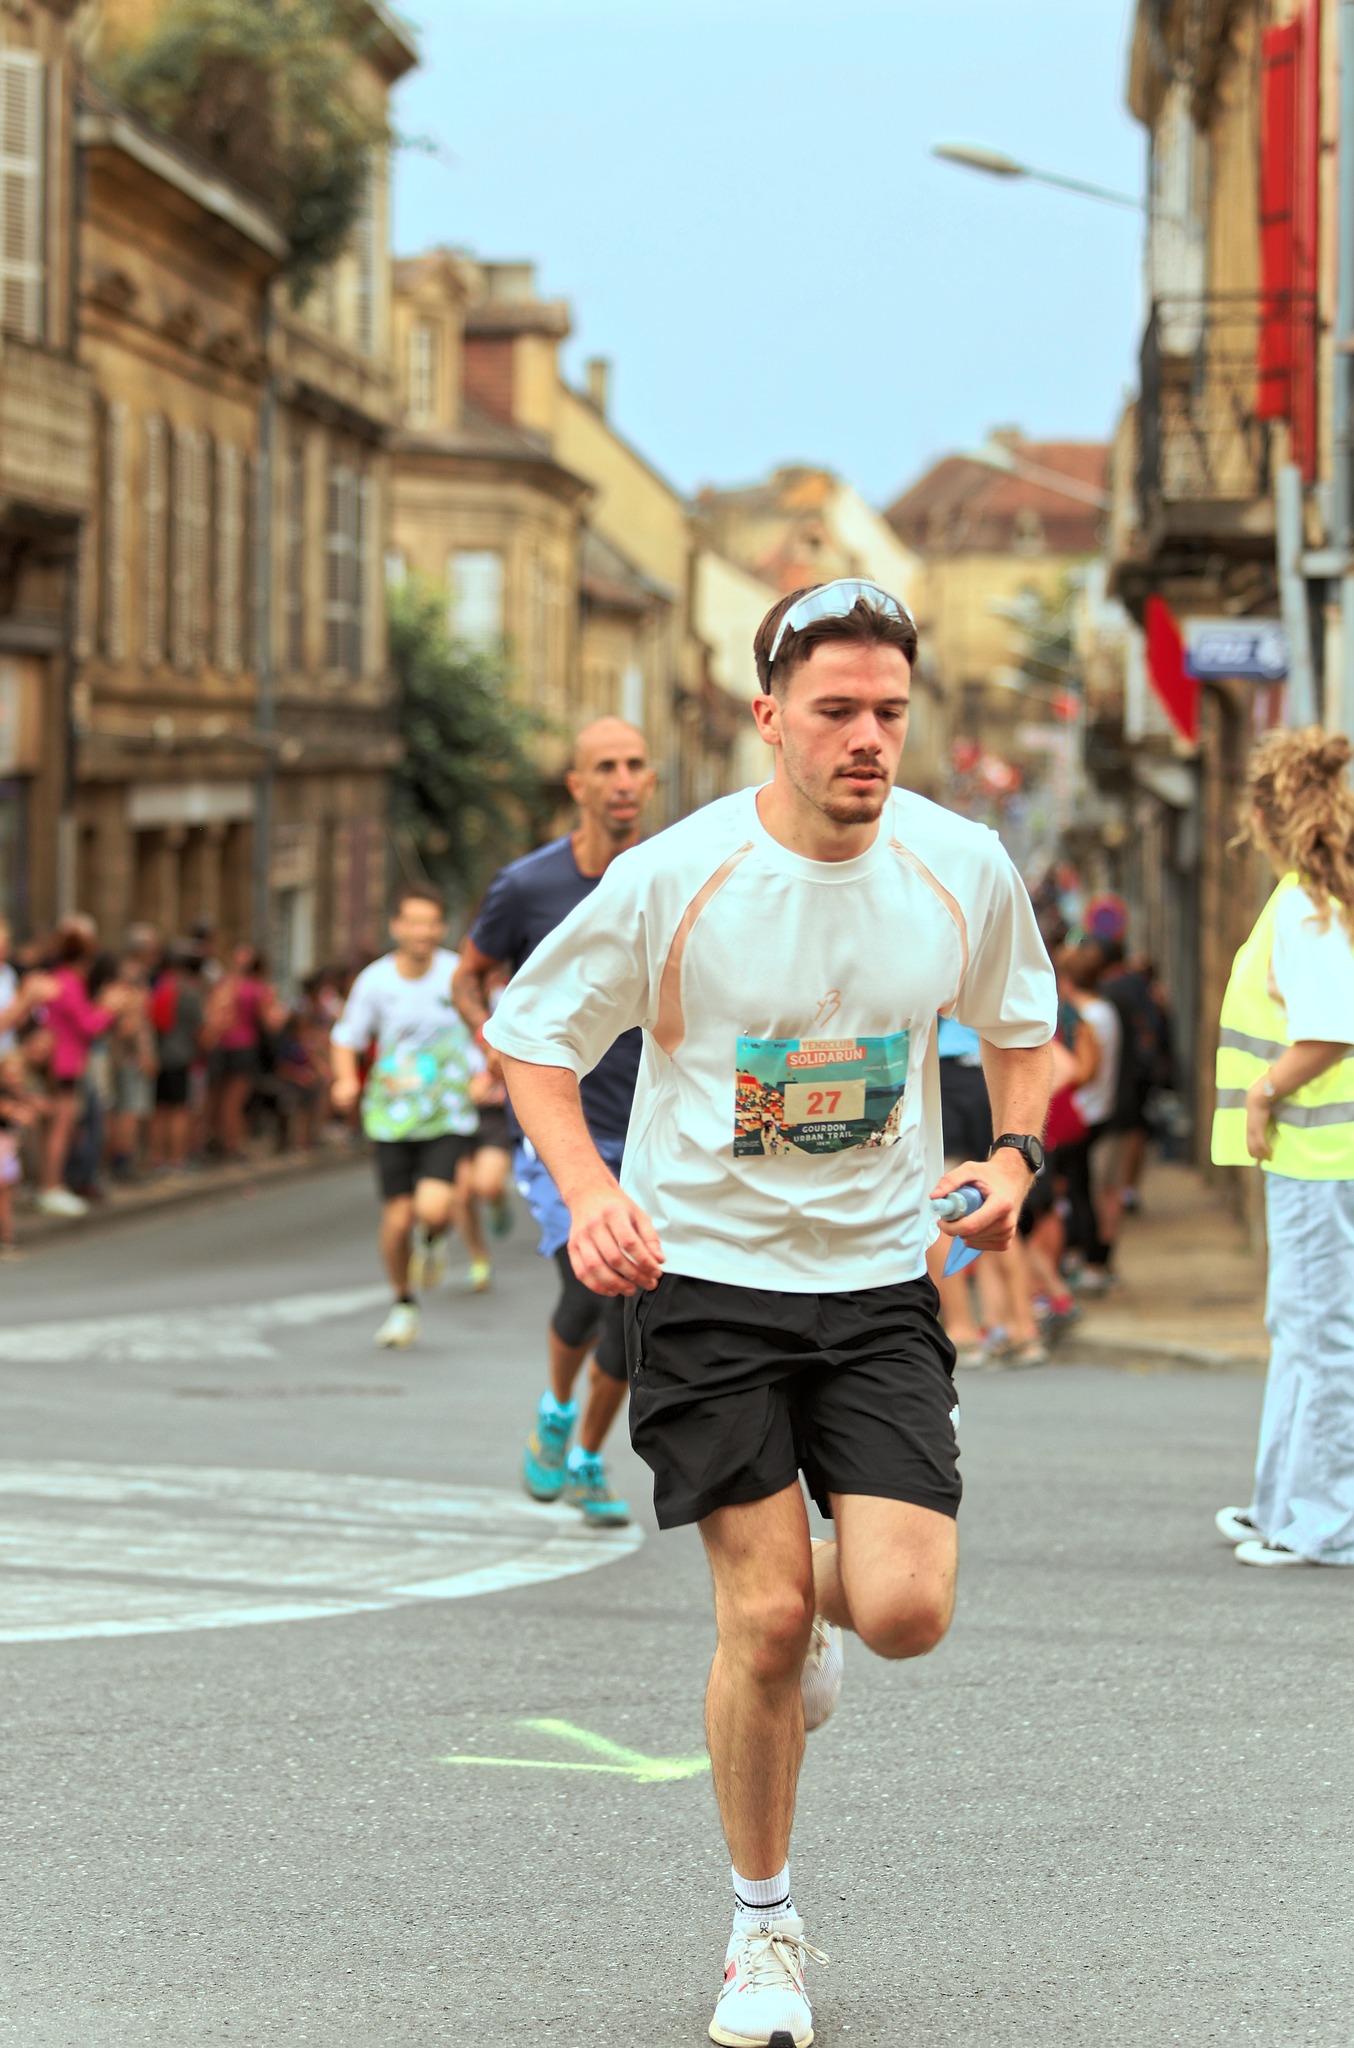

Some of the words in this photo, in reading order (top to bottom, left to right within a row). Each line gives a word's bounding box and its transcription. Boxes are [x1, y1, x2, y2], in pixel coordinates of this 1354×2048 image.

[790, 1048, 863, 1065] SOLIDARUN
[807, 1091, 841, 1115] 27
[802, 1124, 846, 1133] GOURDON
[793, 1133, 824, 1142] URBAN
[828, 1131, 853, 1139] TRAIL
